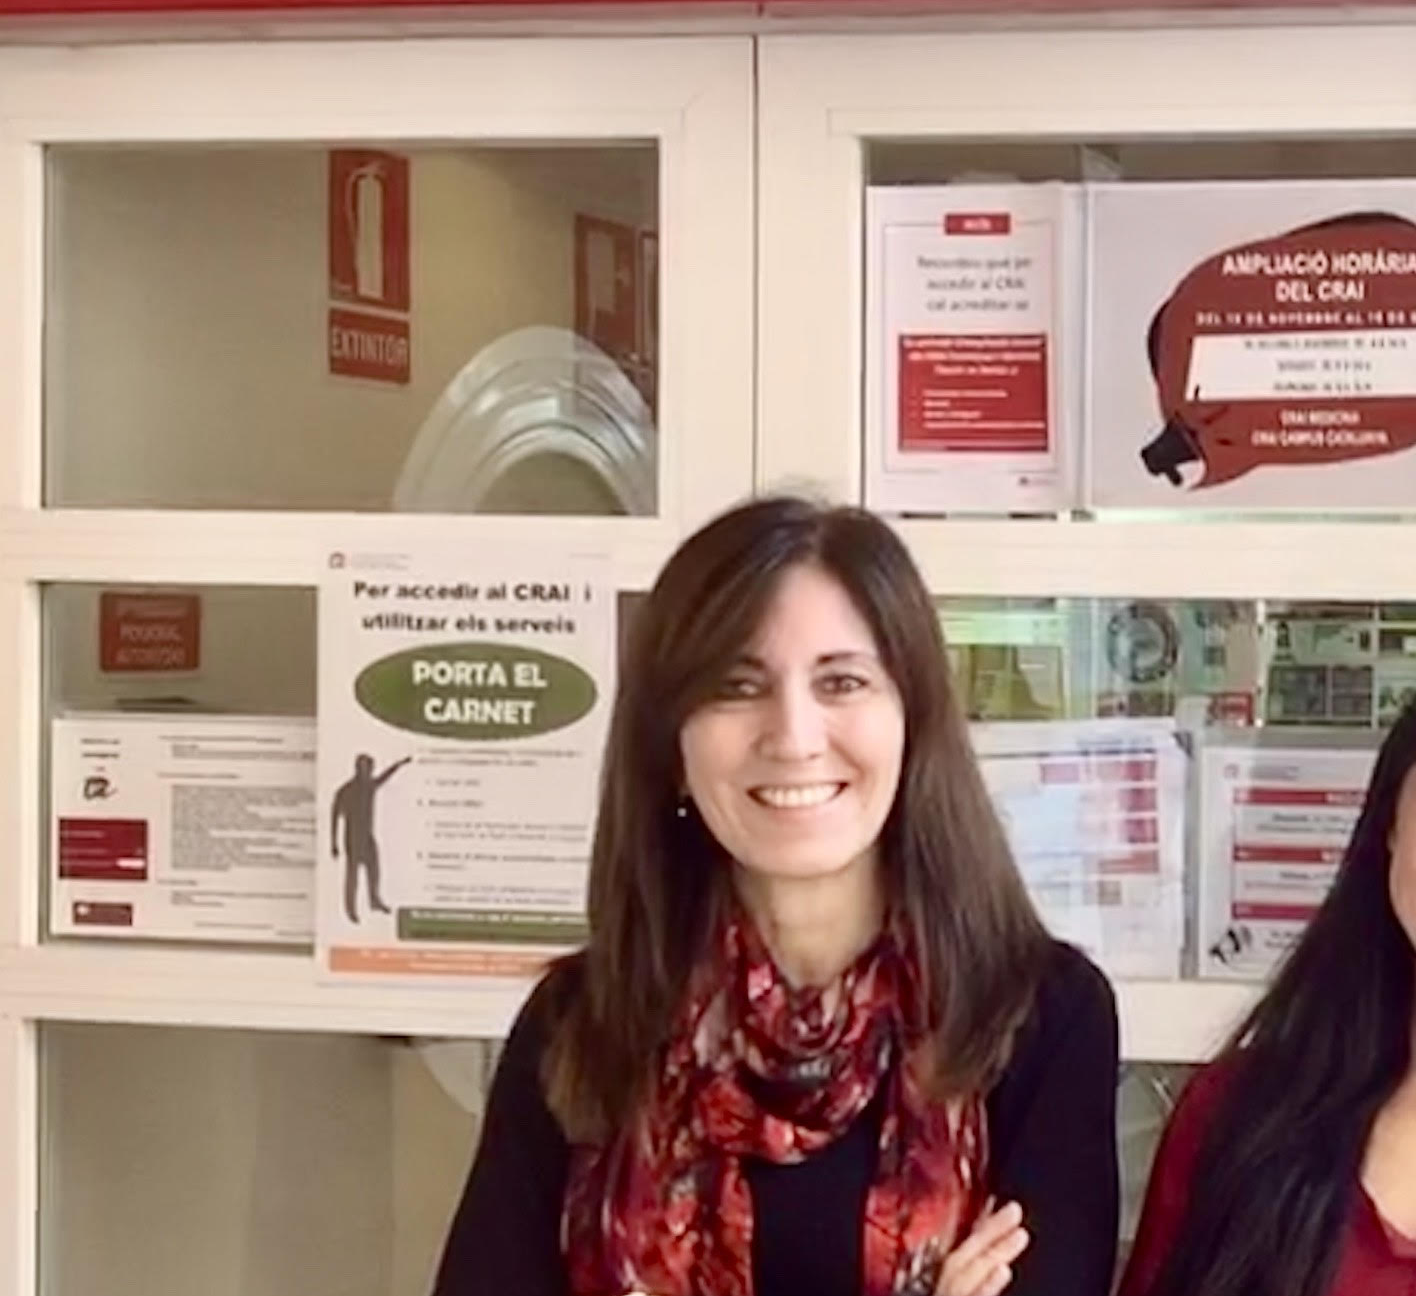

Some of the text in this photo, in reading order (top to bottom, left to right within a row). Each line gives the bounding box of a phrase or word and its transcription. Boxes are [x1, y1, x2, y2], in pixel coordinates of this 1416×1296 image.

[1222, 250, 1327, 276] AMPLIACIÓ
[1275, 279, 1365, 302] DEL CRAI
[354, 581, 389, 600] Per
[396, 581, 479, 601] accedir
[486, 582, 506, 601] al
[514, 583, 569, 602] CRAI
[362, 612, 576, 633] utilitzar els serveis
[412, 660, 547, 688] PORTA EL
[424, 697, 536, 725] CARNET
